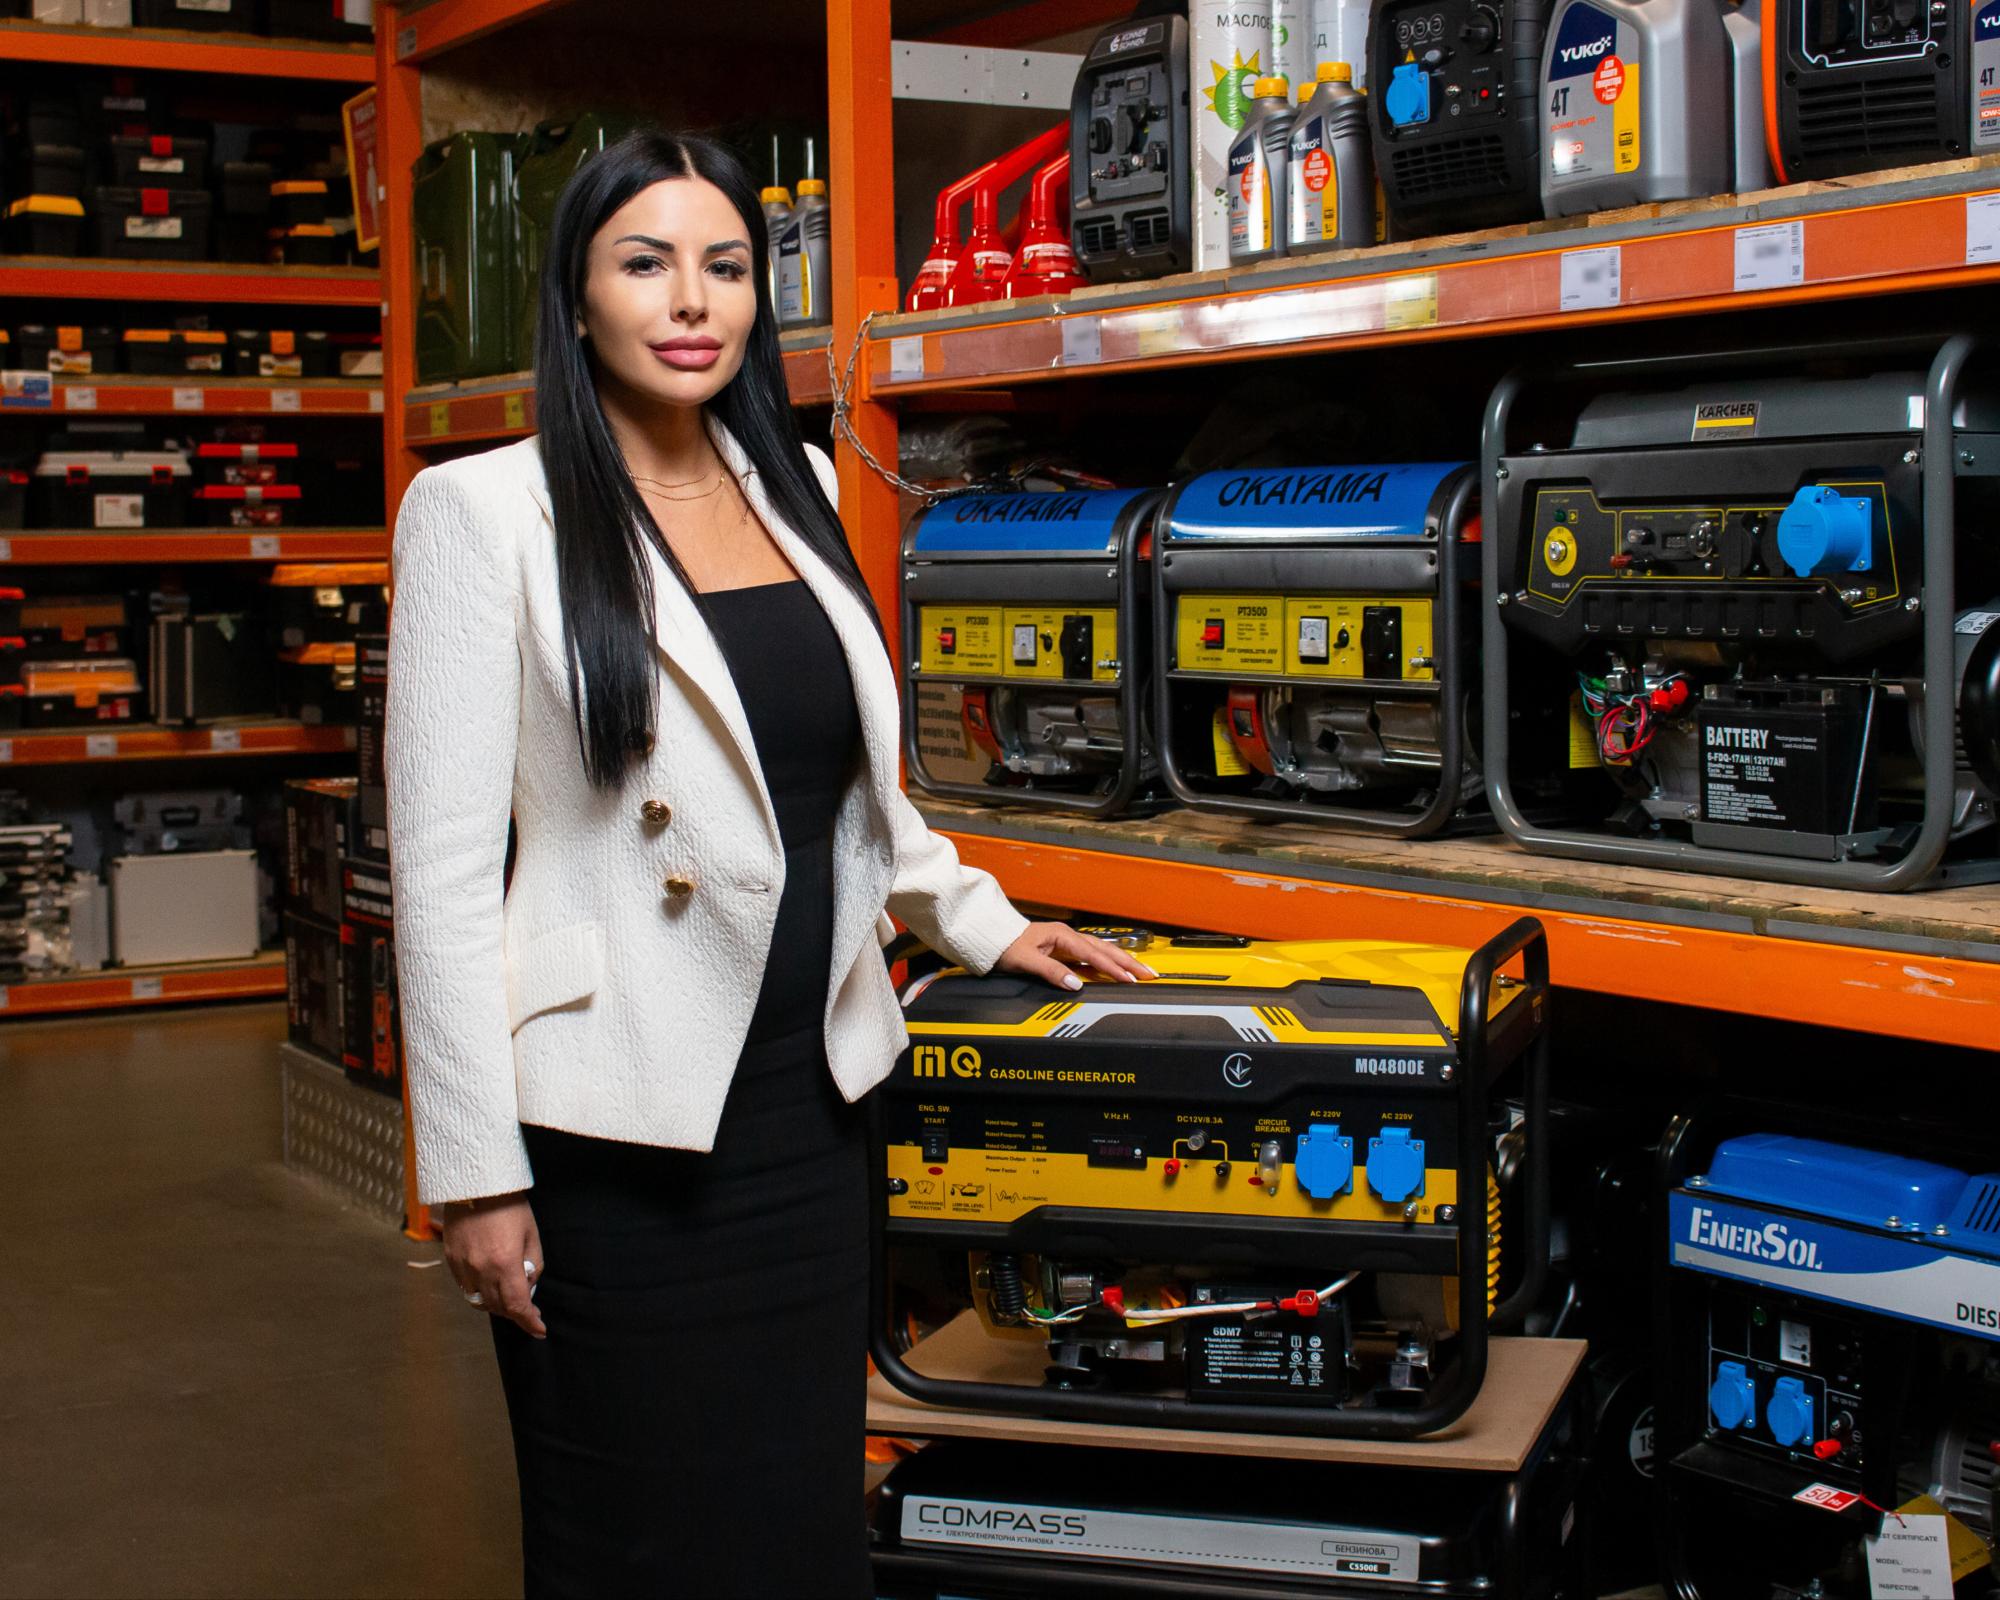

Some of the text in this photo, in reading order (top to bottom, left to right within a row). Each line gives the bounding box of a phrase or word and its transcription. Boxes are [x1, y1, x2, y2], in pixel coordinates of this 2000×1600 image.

[1560, 39, 1607, 63] YUKO
[1980, 67, 1996, 86] 4T
[1551, 87, 1570, 117] 4T
[1217, 471, 1390, 507] OKAYAMA
[955, 496, 1088, 524] OKAYAMA
[1237, 606, 1268, 617] PT3500
[1706, 726, 1769, 750] BATTERY
[1355, 1058, 1425, 1075] MQ4800E
[990, 1068, 1054, 1081] GASOLINE
[1057, 1071, 1136, 1084] GENERATOR
[1322, 1110, 1342, 1118] 220V
[1258, 1118, 1288, 1126] CIRCUIT
[1255, 1126, 1291, 1134] BREAKER
[1212, 1327, 1242, 1337] 6DM7
[1254, 1331, 1284, 1339] CAUTION
[1805, 1488, 1832, 1501] 50
[919, 1504, 1086, 1537] COMPASS
[946, 1530, 1054, 1545] ЕЛЕКТРОГЕНЕРАТОРНА УСТАНОВКА
[1892, 1533, 1938, 1542] CERTIFICATE
[1335, 1544, 1386, 1556] БЕНЗИНОВА
[1348, 1562, 1379, 1572] C5500E
[1875, 1557, 1903, 1566] MODEL:
[1878, 1583, 1920, 1592] INSPECTOR:
